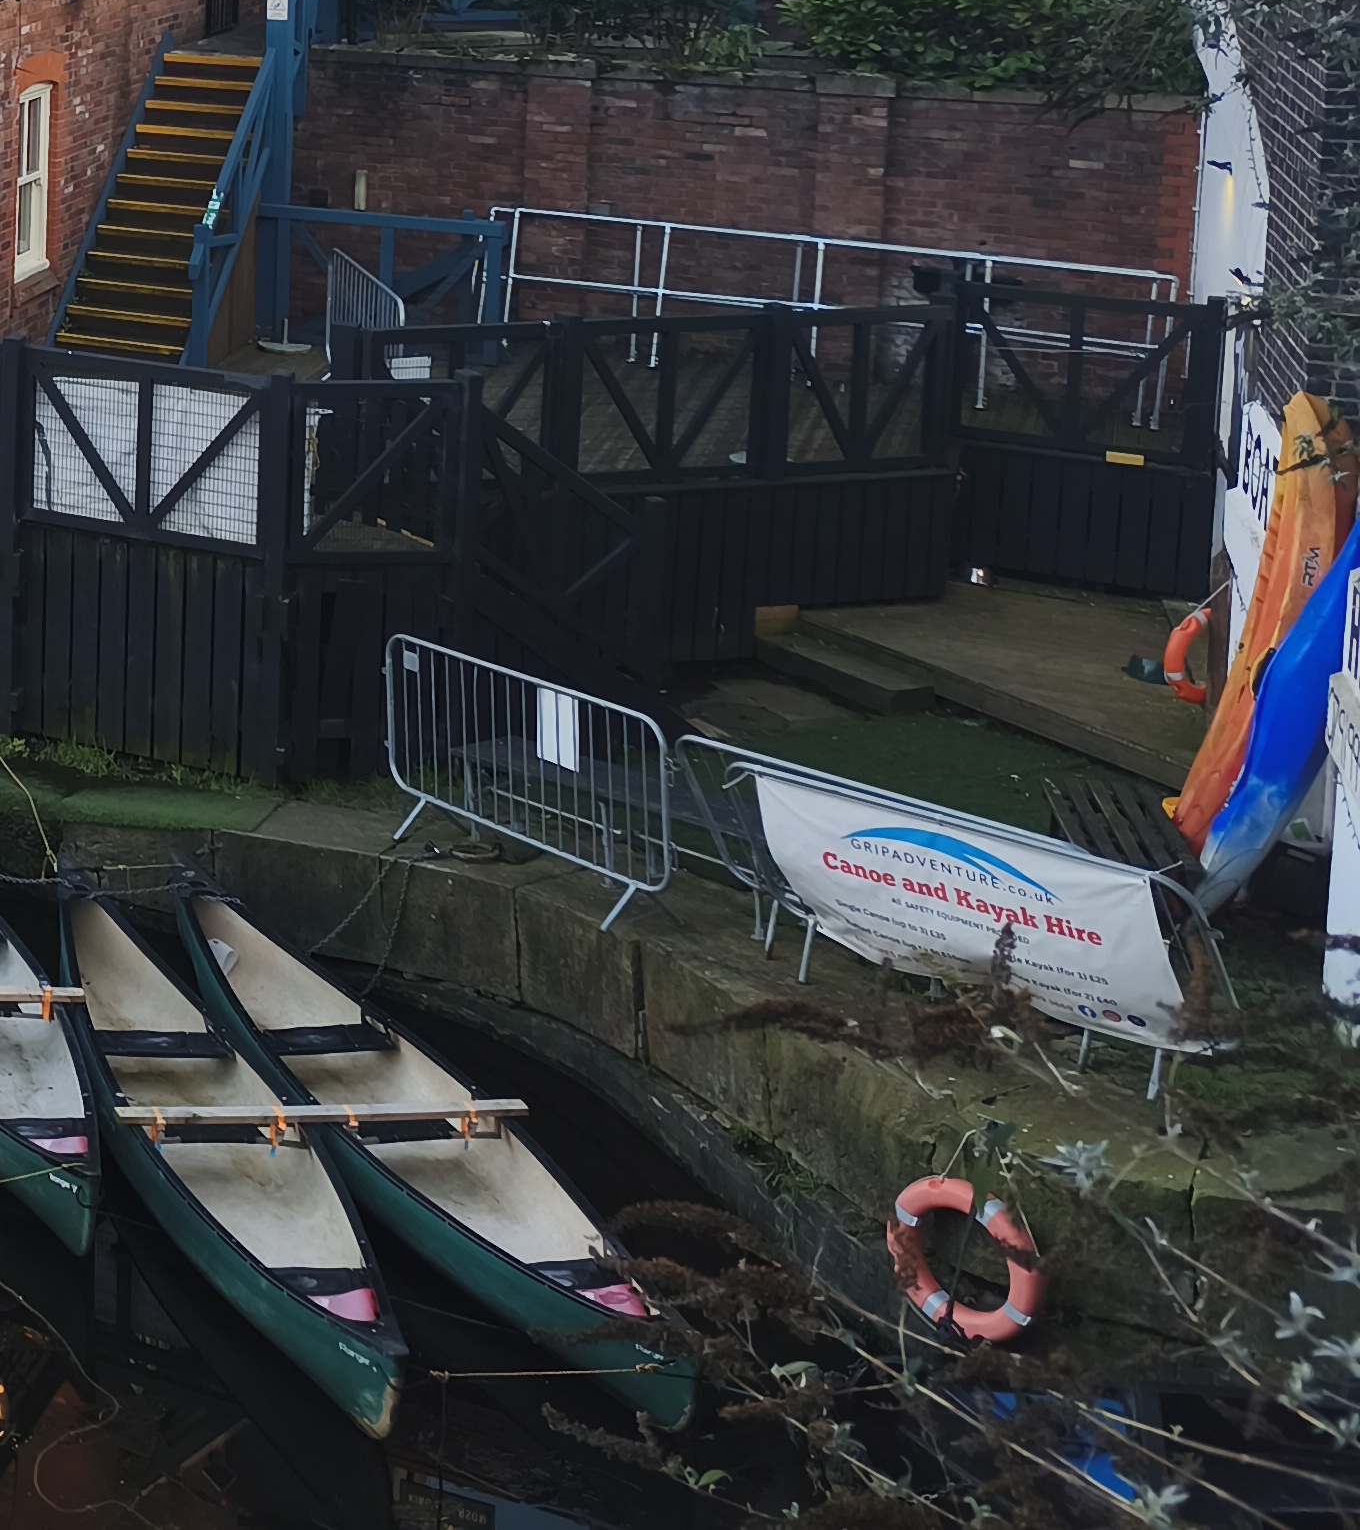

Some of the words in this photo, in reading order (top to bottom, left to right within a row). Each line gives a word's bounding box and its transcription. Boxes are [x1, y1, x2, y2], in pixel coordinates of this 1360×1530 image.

[851, 838, 1055, 906] GRIPADVENTURE.co.uk
[823, 852, 896, 887] Canoe
[902, 878, 949, 902] and
[954, 887, 1039, 929] Kayak
[1043, 914, 1103, 946] Hire
[863, 908, 890, 923] Canoe
[908, 923, 918, 932] to
[930, 929, 946, 940] £35
[905, 901, 934, 915] SAFETY
[936, 911, 983, 931] EQUIPMENT
[1025, 959, 1055, 972] Kayak
[1057, 966, 1074, 977] (for
[1089, 975, 1109, 986] £25
[1031, 980, 1062, 993] Kayak
